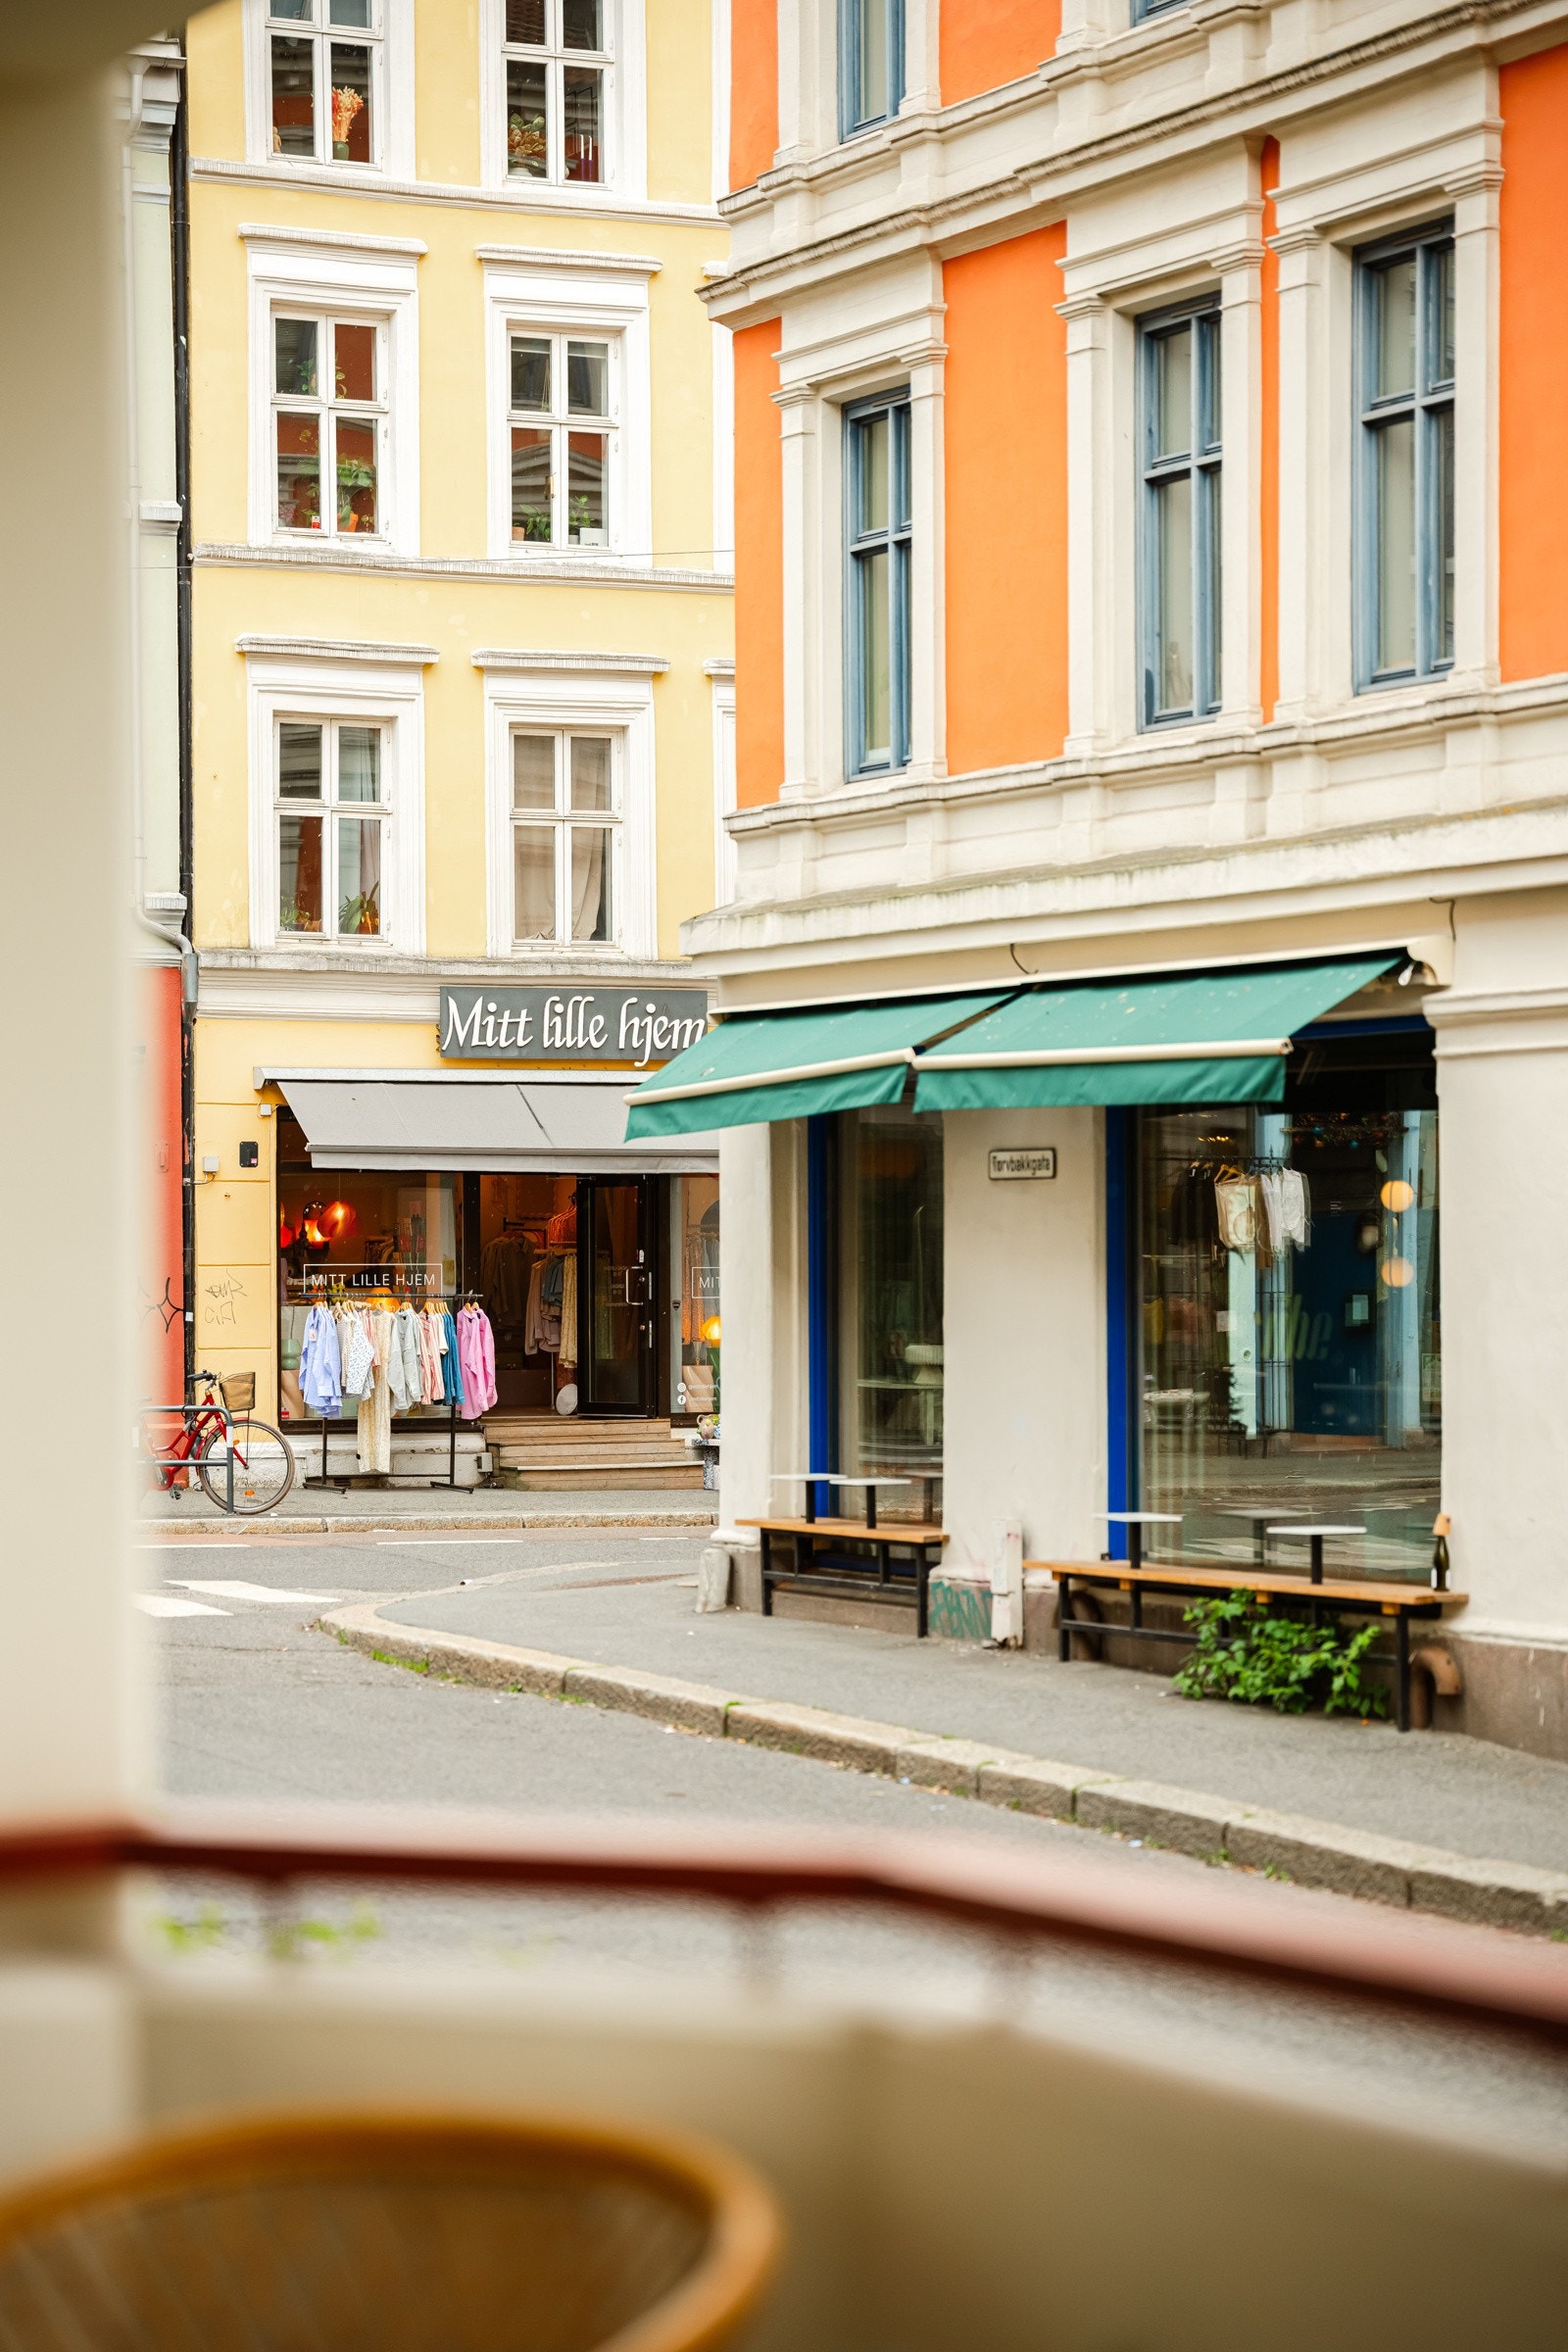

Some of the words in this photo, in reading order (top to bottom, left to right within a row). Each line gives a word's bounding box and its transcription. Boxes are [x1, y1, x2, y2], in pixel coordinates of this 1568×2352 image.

[441, 996, 532, 1051] Mitt
[543, 996, 608, 1049] lille
[618, 997, 706, 1066] hjem
[312, 1274, 346, 1286] MITT
[353, 1274, 389, 1286] LILLE
[396, 1274, 434, 1286] HJEM
